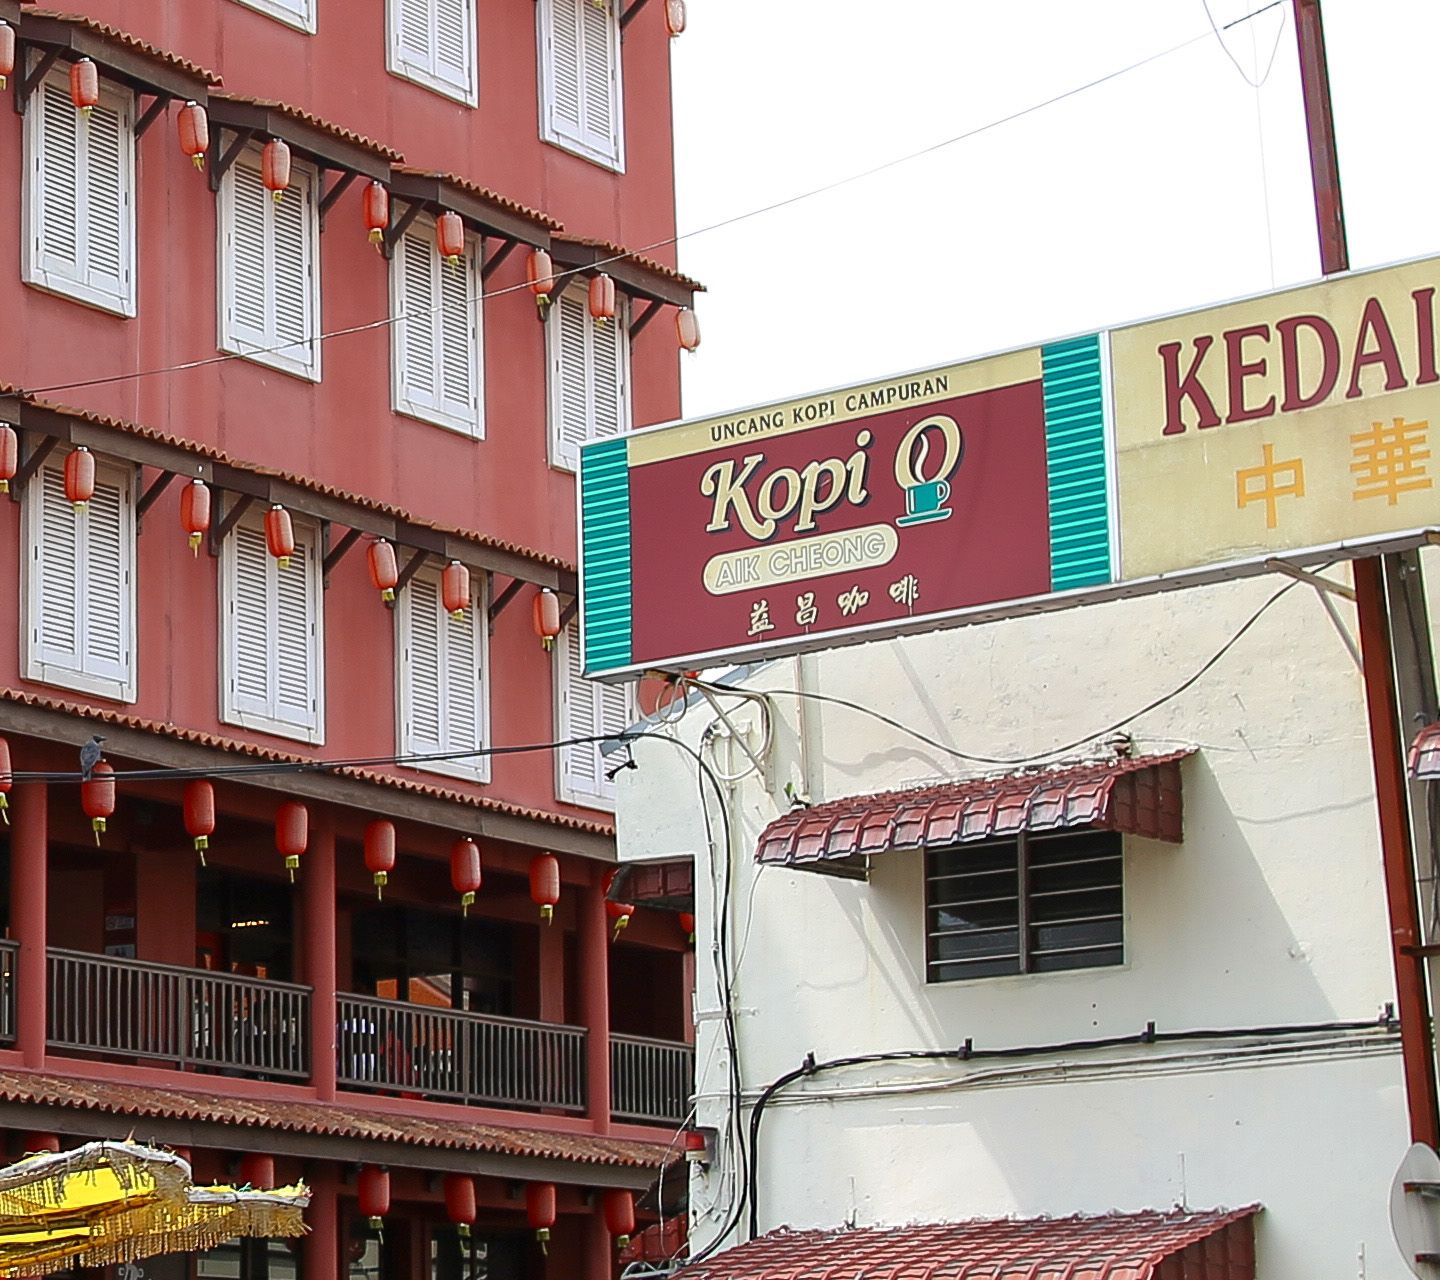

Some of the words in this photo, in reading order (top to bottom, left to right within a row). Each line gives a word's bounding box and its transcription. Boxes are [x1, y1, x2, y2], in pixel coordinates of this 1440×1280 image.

[1157, 286, 1440, 439] KEDAI
[710, 410, 785, 443] UNCANG
[791, 399, 837, 426] KOPI
[844, 375, 950, 413] CAMPURAN
[698, 428, 874, 541] Kopi
[715, 558, 761, 589] AIK
[767, 534, 887, 579] CHEONG
[746, 573, 921, 637] 益昌咖啡
